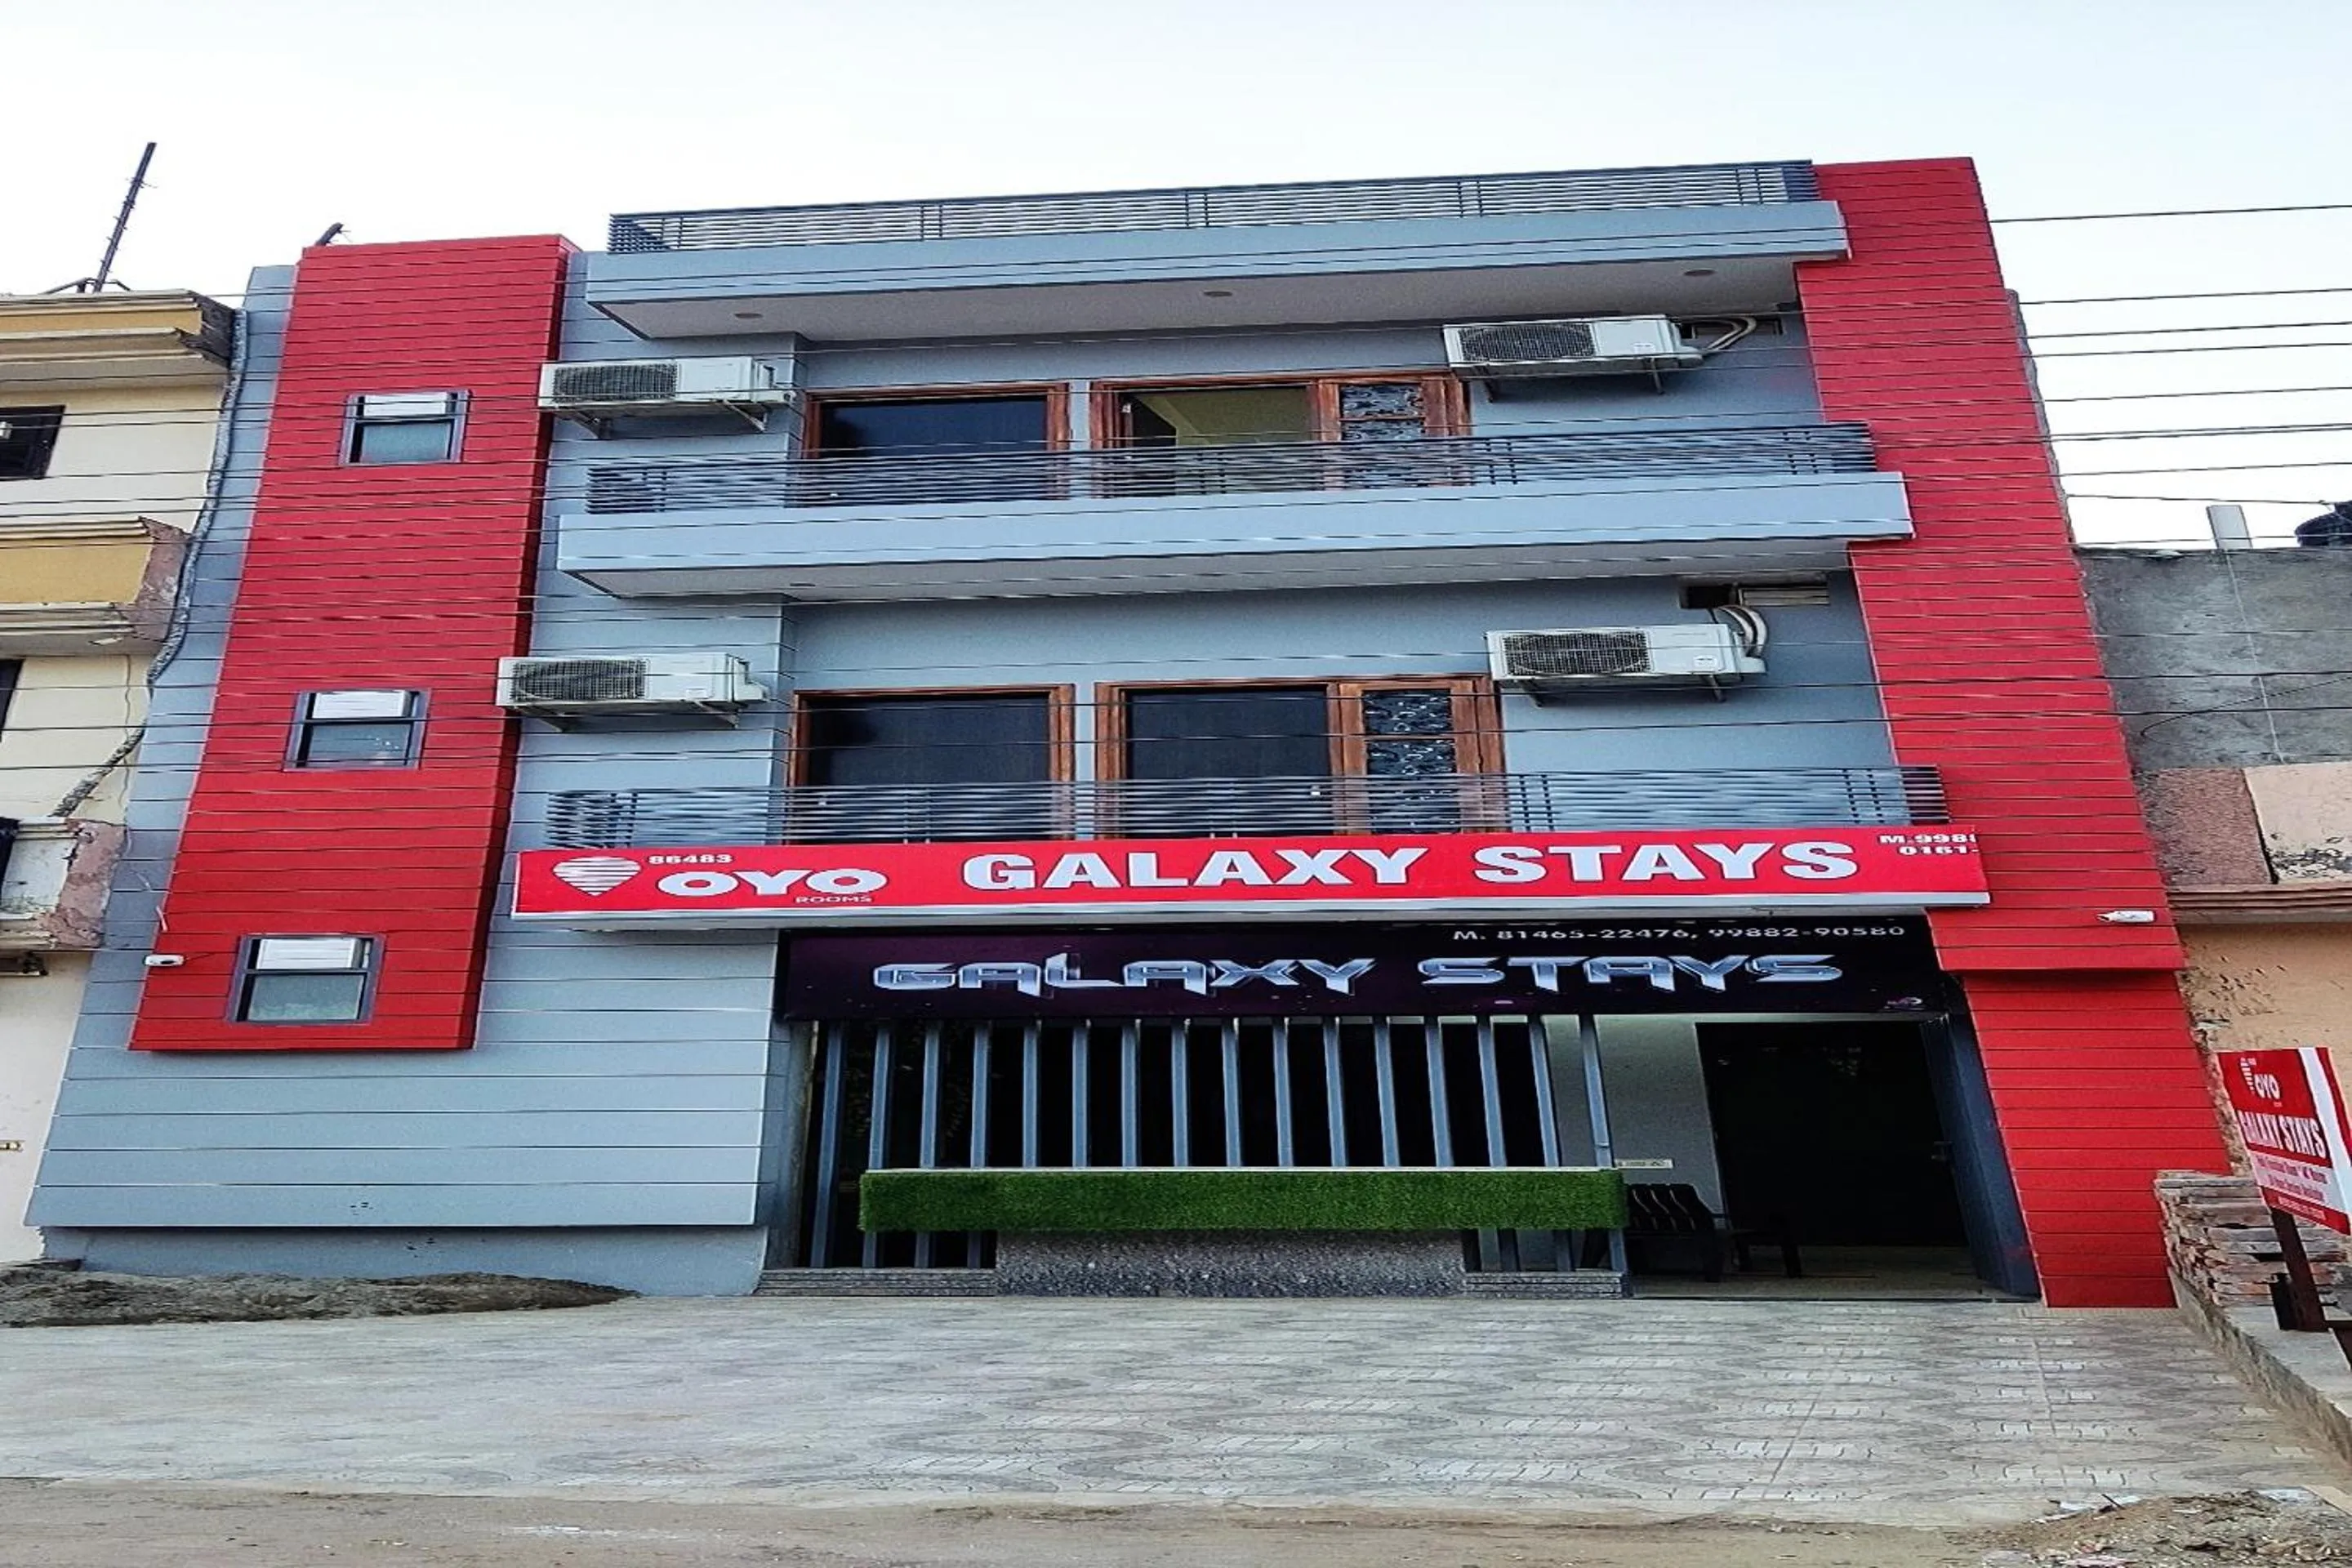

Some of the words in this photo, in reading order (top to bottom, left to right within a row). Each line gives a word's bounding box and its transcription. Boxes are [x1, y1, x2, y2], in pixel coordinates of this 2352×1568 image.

[648, 853, 733, 865] 86483
[657, 868, 889, 897] OYO
[962, 848, 1429, 891] GALAXY
[1473, 841, 1859, 885] STAYS
[1453, 930, 1486, 940] M.
[872, 952, 1375, 996] GALAXY
[1418, 954, 1844, 992] STAYS
[2278, 1116, 2327, 1159] STAYS
